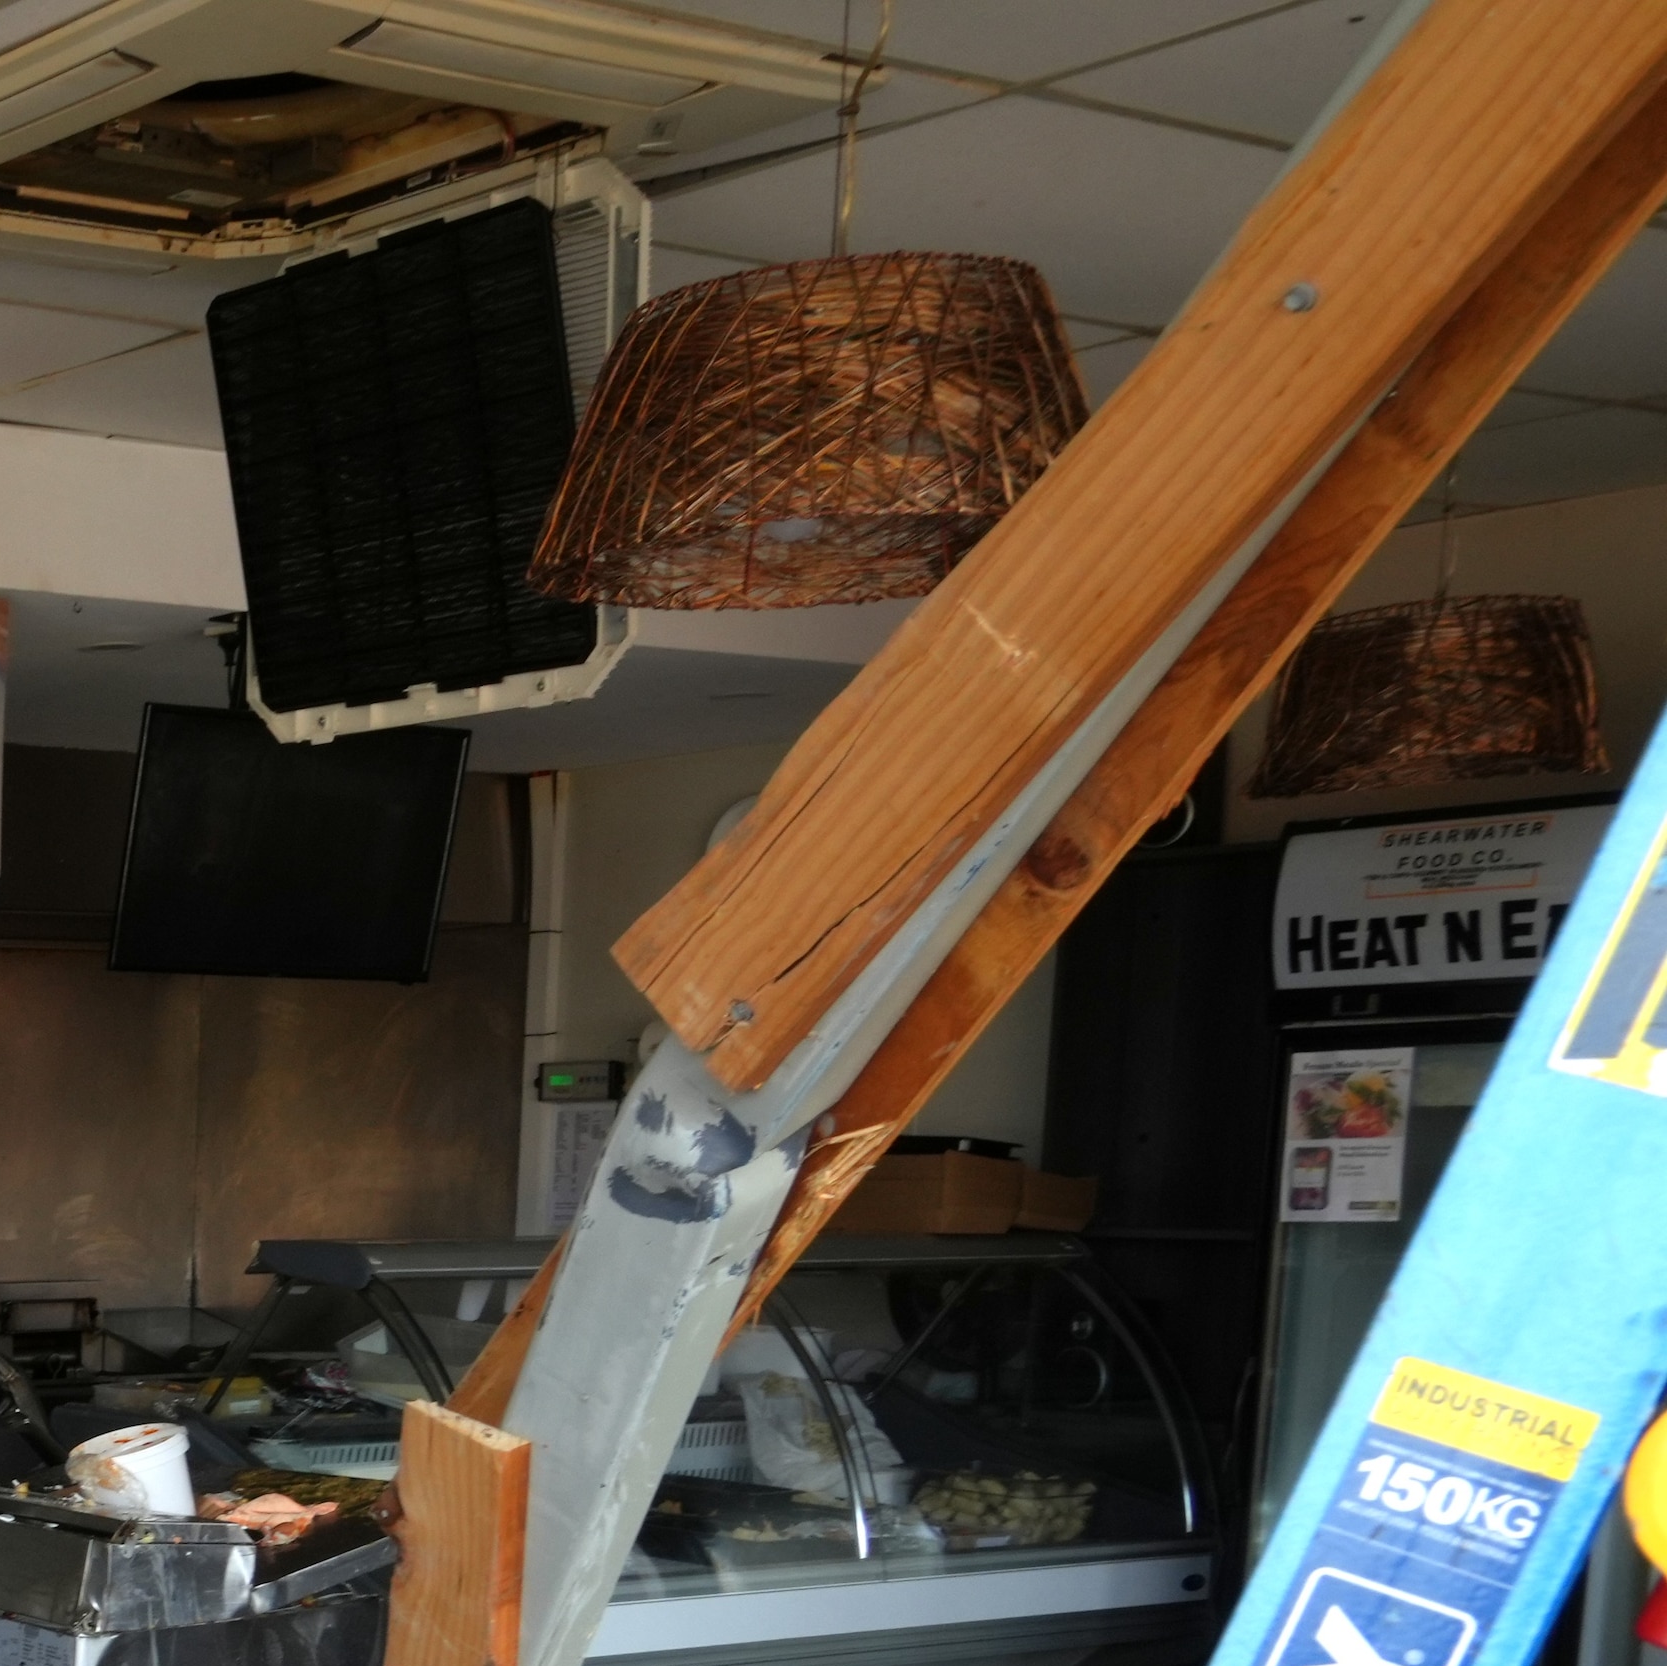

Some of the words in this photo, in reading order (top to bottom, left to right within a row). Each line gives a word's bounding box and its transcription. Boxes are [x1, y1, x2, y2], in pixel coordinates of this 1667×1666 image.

[1383, 821, 1547, 848] SHEARWATER
[1396, 853, 1464, 870] FOOD
[1289, 914, 1429, 974] HEAT
[1443, 909, 1483, 963] N
[1397, 1374, 1575, 1447] INDUSTRIAL
[1357, 1454, 1542, 1540] 150KG
